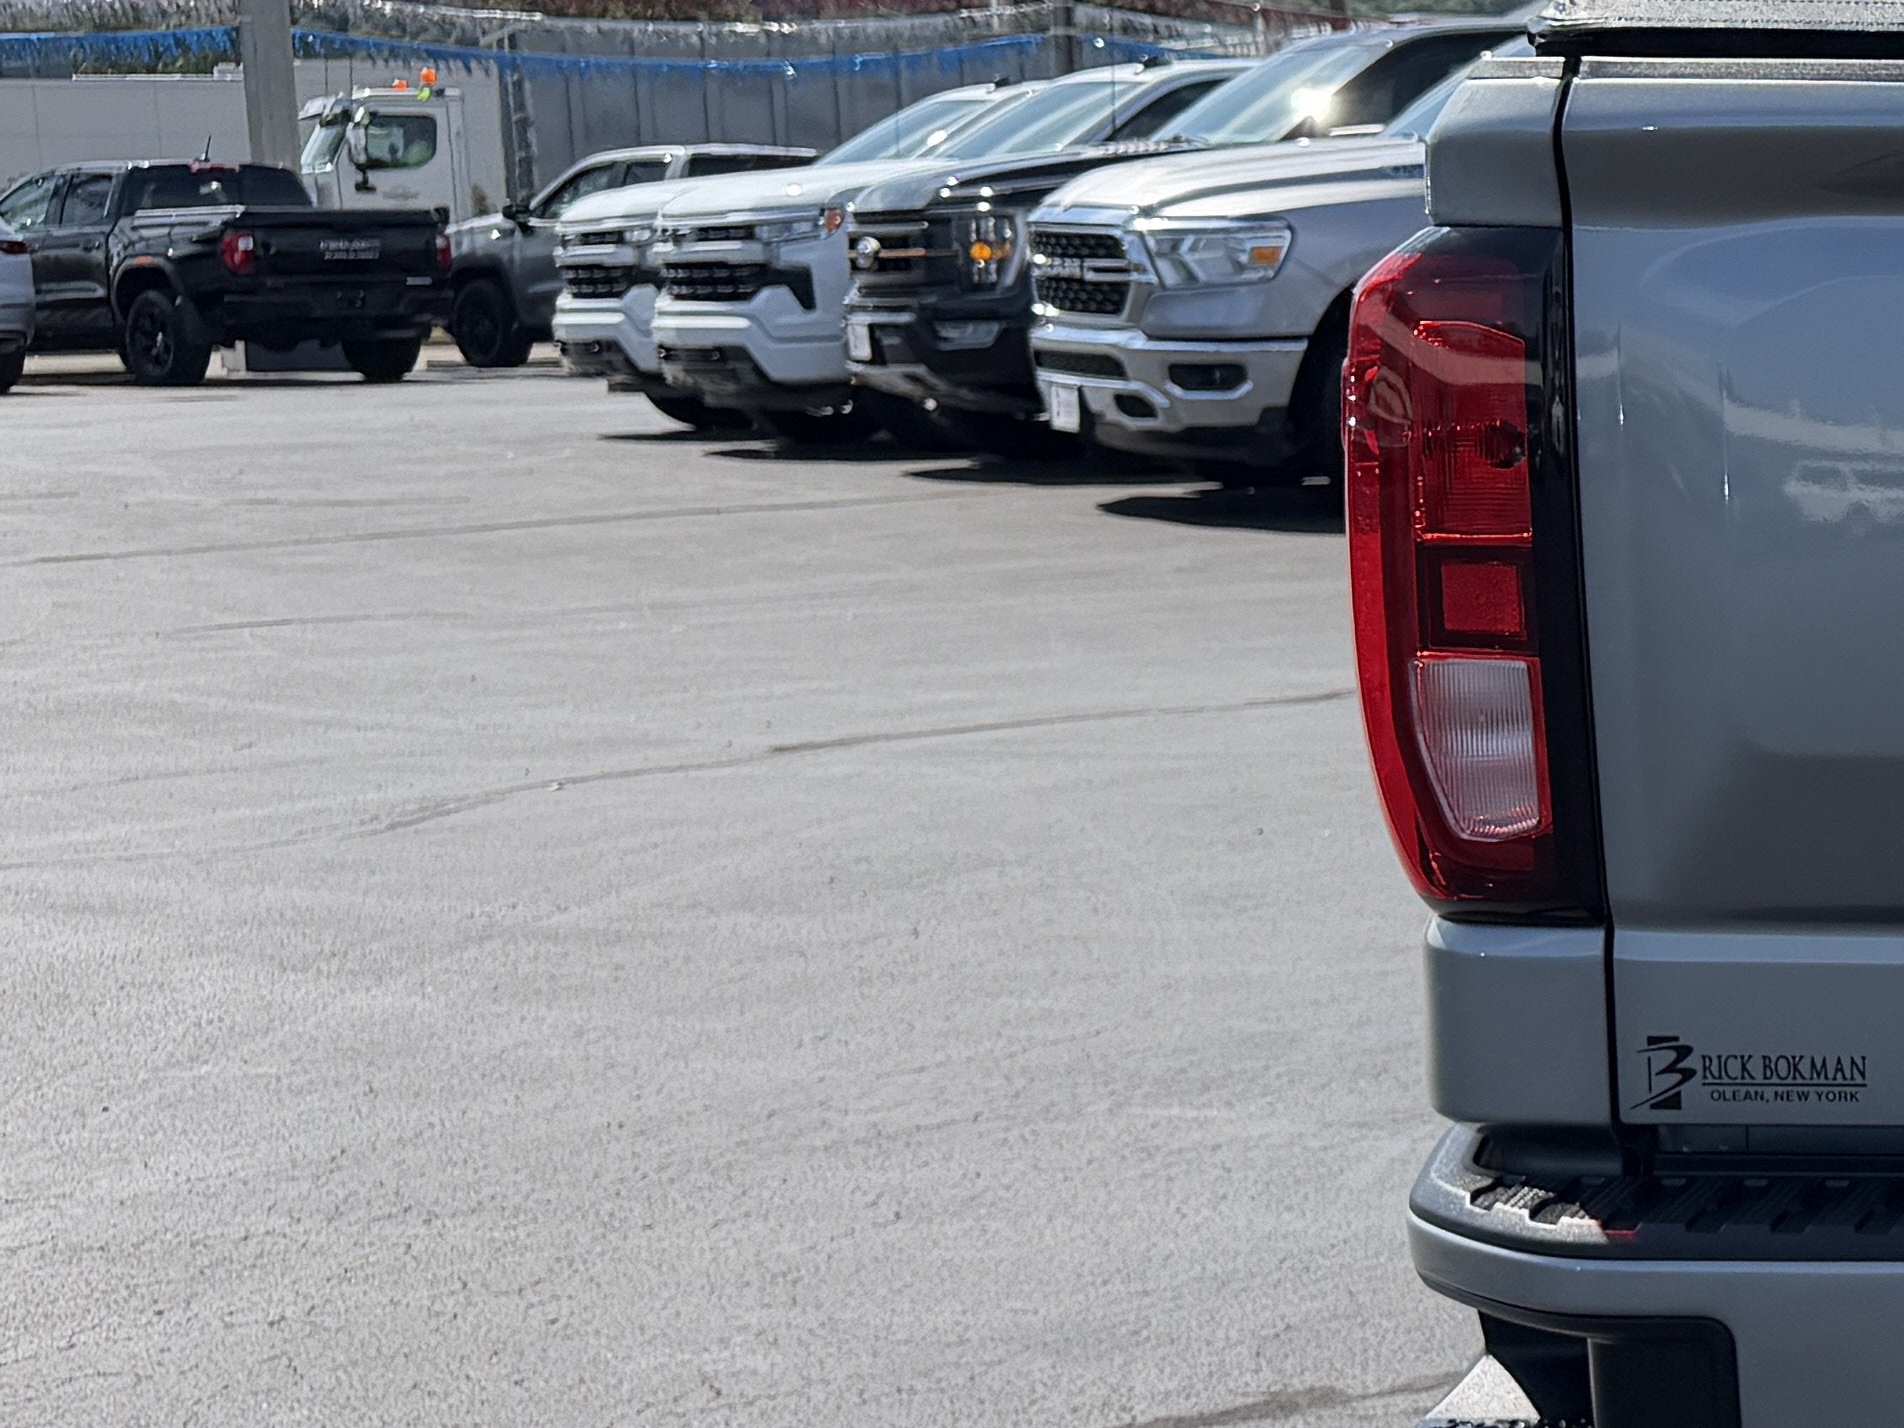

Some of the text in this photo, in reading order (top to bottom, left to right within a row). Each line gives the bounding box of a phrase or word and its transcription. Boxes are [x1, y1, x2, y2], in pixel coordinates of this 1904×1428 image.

[1700, 1053, 1868, 1082] RICK BOKMAN
[1710, 1088, 1861, 1104] OLEAN, NEW YORK
